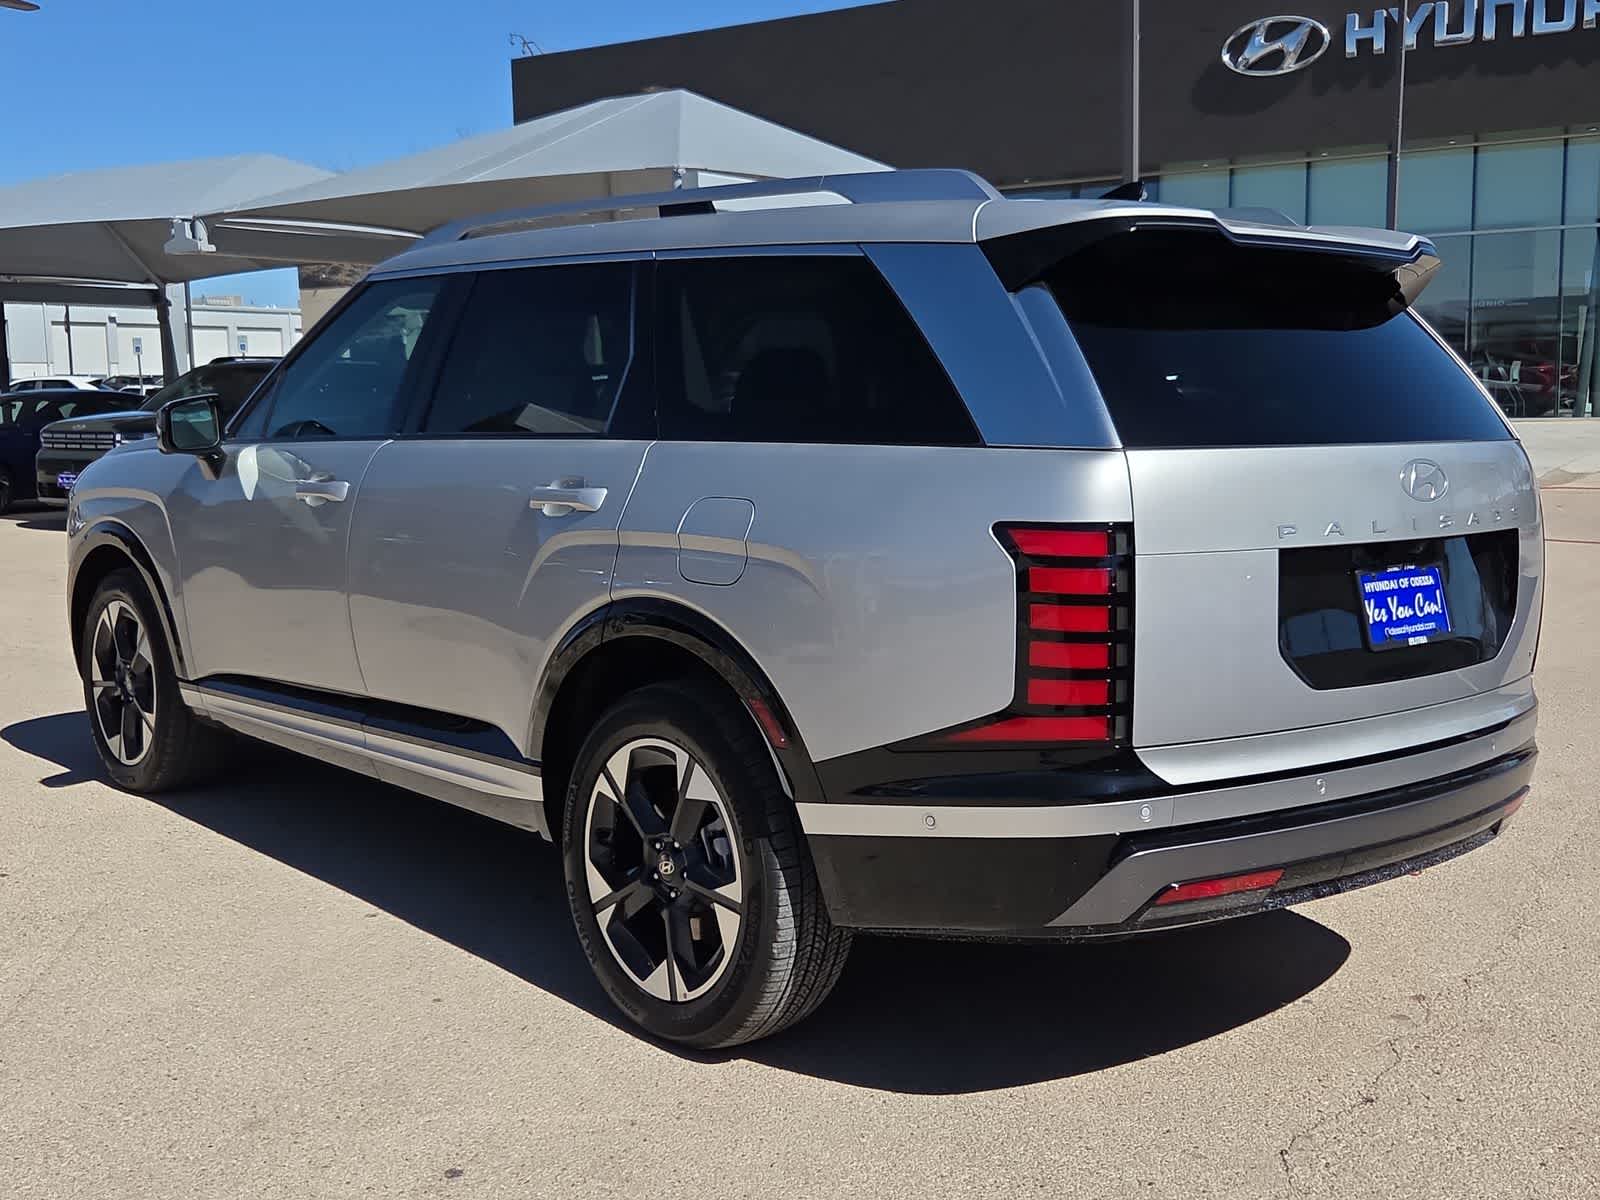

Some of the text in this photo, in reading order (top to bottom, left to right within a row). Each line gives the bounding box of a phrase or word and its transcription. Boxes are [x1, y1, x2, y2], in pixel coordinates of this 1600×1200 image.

[1364, 575, 1435, 593] HYUNDAI OF ODESSA
[1364, 589, 1442, 625] Yes You Can!
